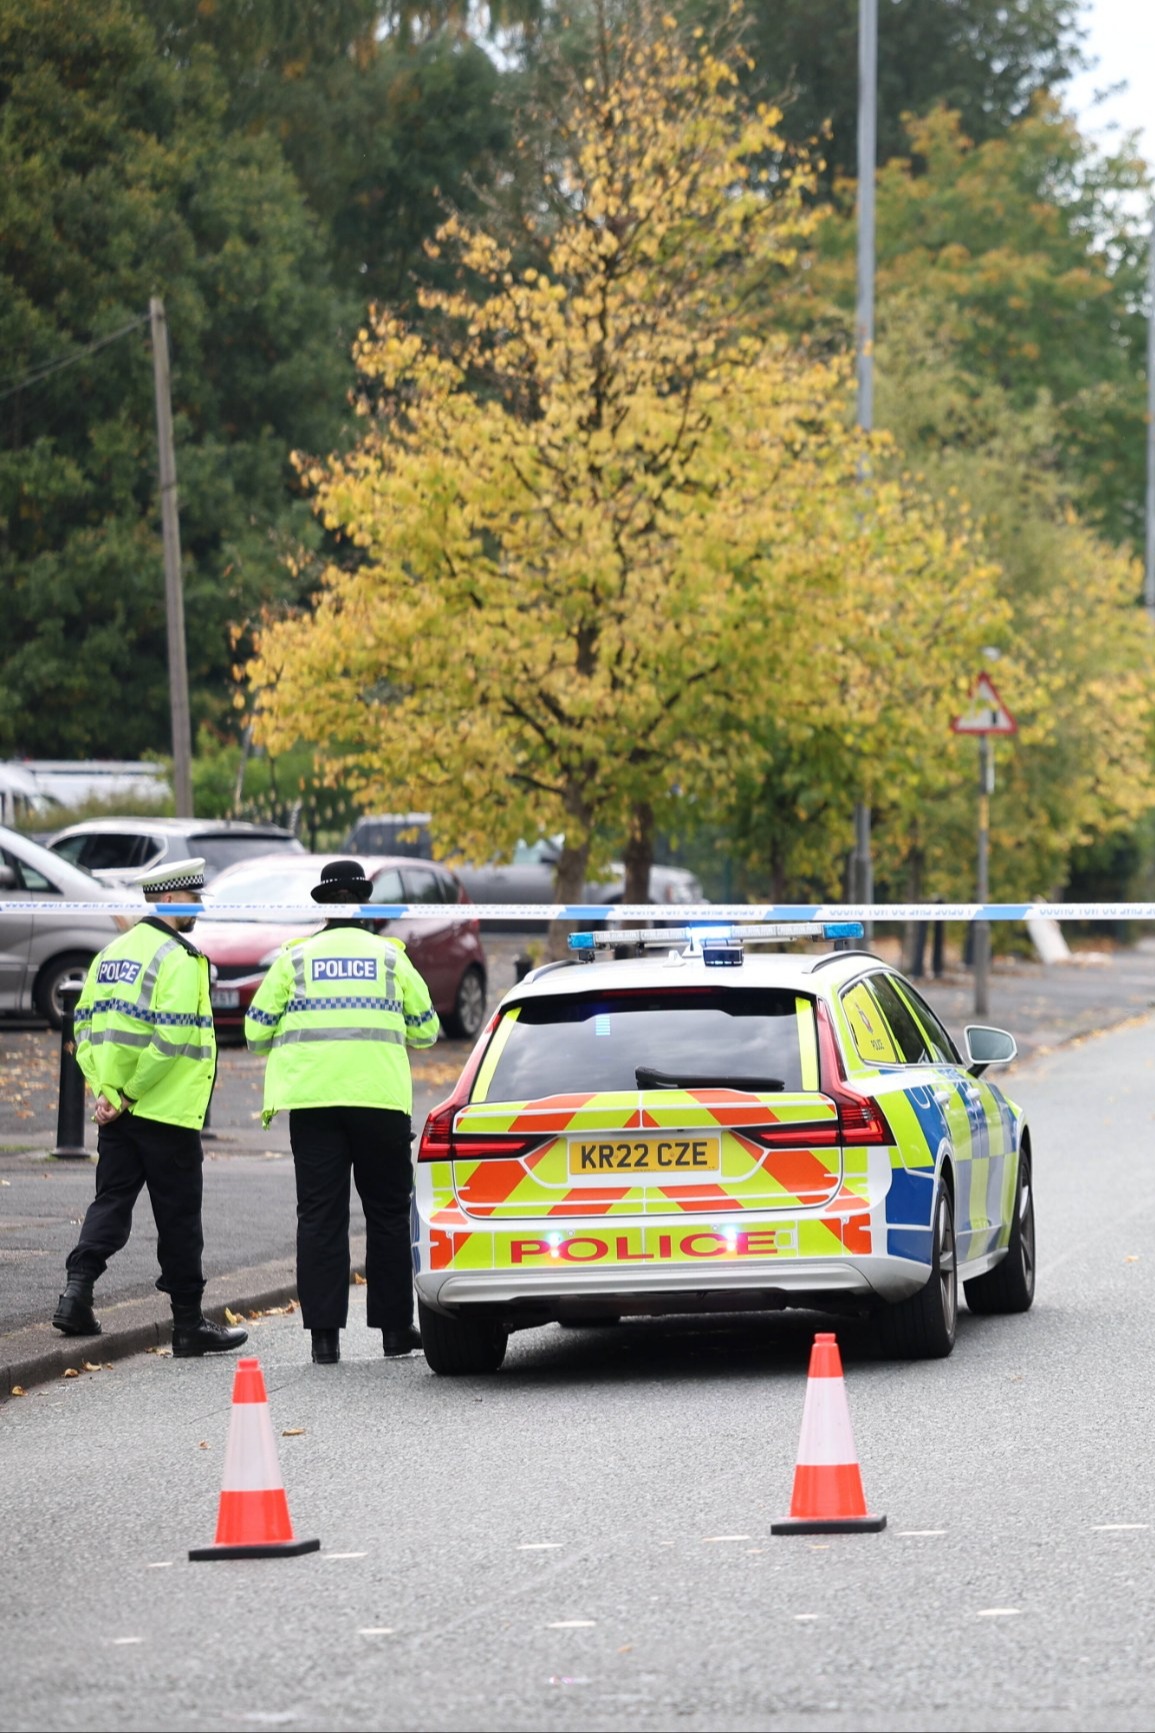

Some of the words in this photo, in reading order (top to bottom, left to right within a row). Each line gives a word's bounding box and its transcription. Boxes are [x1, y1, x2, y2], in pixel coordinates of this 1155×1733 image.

[100, 960, 140, 983] POLCE
[313, 959, 375, 979] POLICE
[580, 1144, 649, 1168] KR22
[657, 1142, 708, 1167] CZE
[510, 1231, 778, 1264] POLICE
